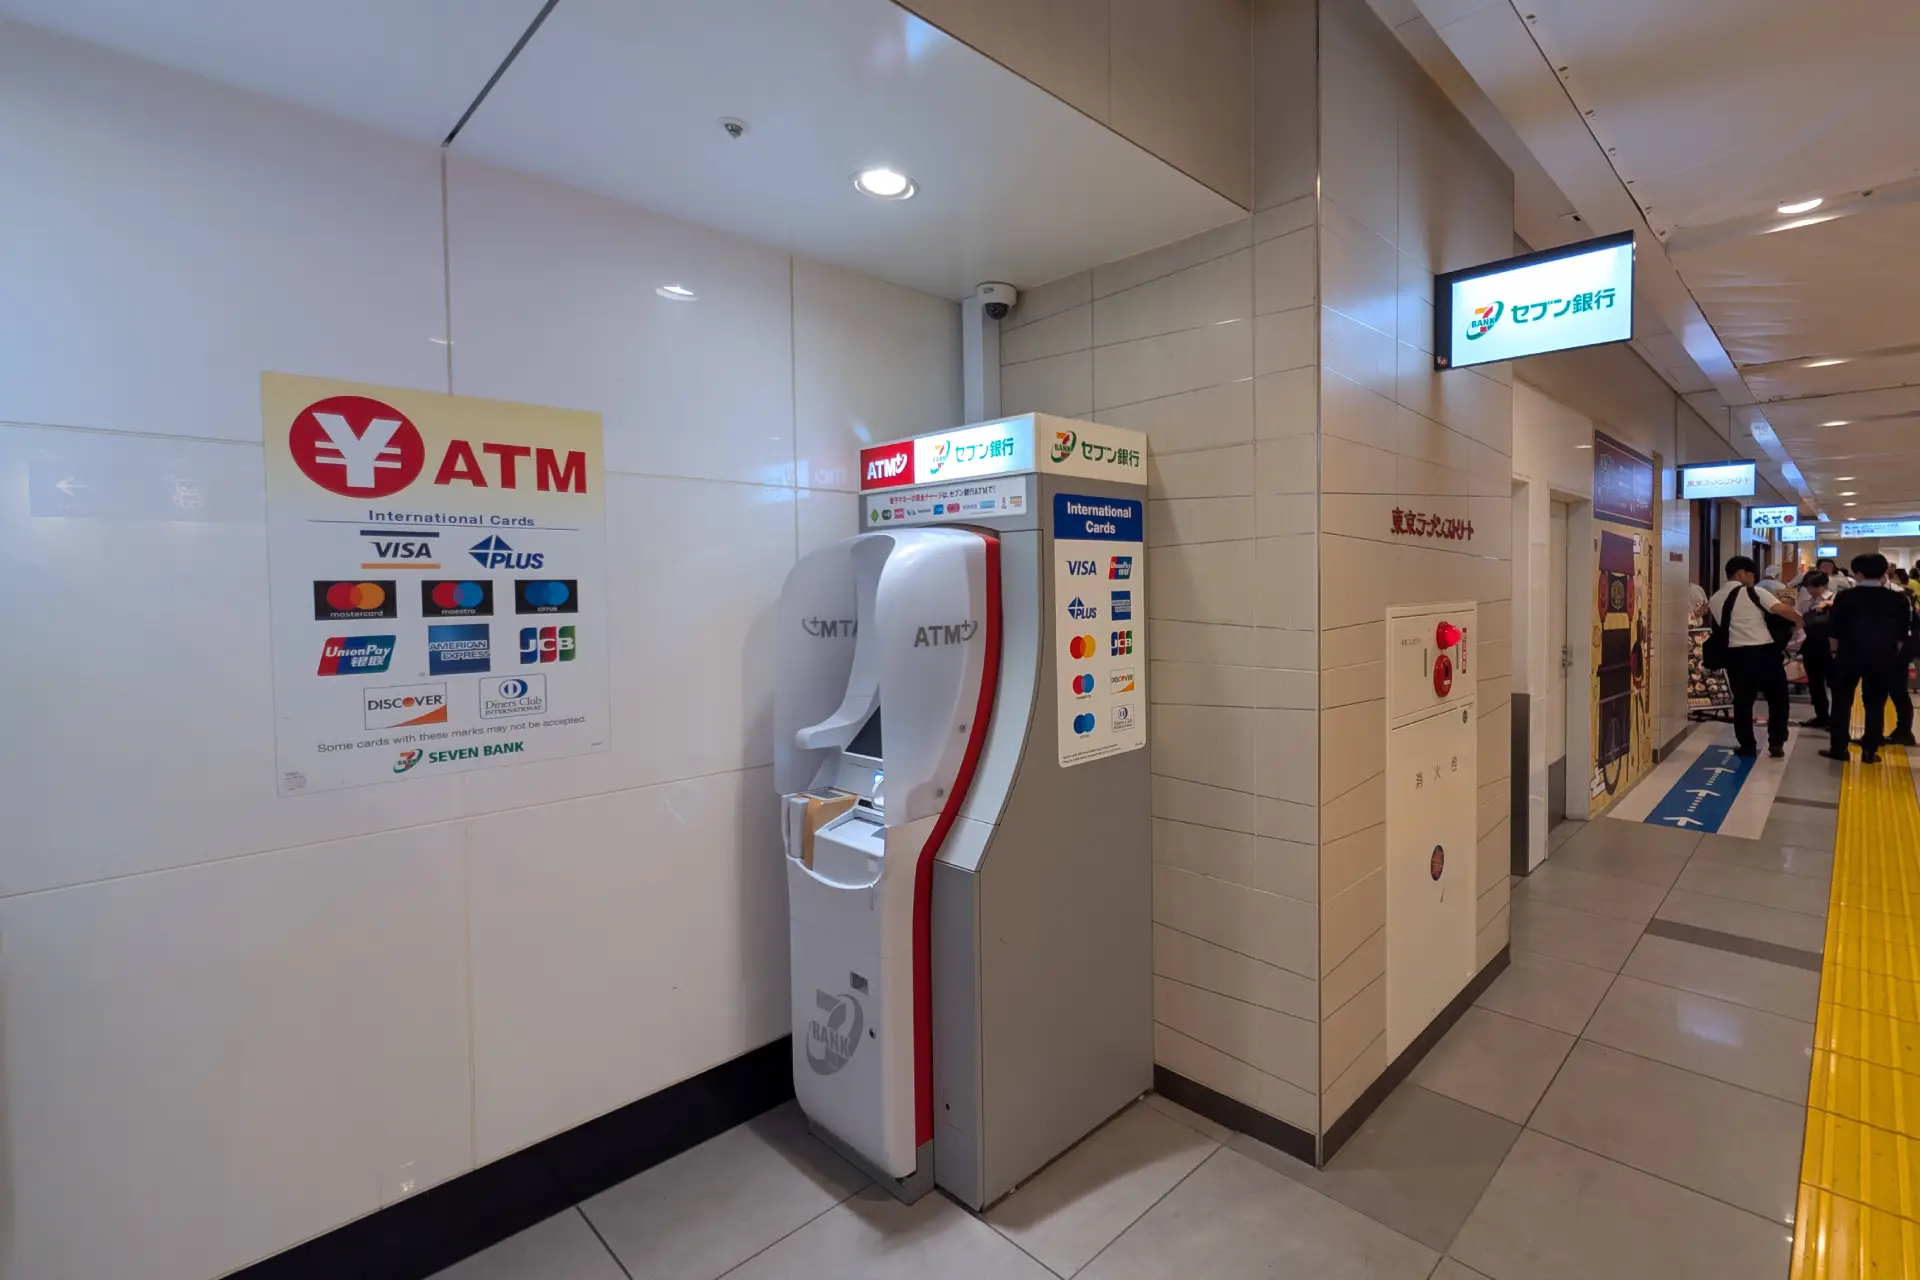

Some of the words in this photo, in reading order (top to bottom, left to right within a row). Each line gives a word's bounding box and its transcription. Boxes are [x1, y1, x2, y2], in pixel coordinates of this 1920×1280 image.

[1511, 288, 1616, 324] セブン銀行
[1472, 317, 1496, 329] BANK
[955, 437, 1014, 463] セブン銀行
[1081, 440, 1140, 467] セブン銀行
[434, 439, 587, 494] ATM
[369, 510, 483, 525] International
[490, 514, 535, 527] Cards
[1067, 501, 1132, 519] International
[1085, 520, 1116, 535] Cards
[369, 540, 432, 559] VISA
[490, 552, 545, 570] PLUS
[1066, 559, 1097, 576] VISA
[330, 609, 384, 619] mastercard
[441, 607, 476, 616] maestro
[1075, 606, 1097, 620] PLUS
[325, 644, 392, 659] UnionPay
[429, 640, 488, 652] AMERICAN
[442, 650, 491, 661] EXPRESS
[367, 694, 442, 711] DISCOVER
[485, 698, 516, 710] Diners
[519, 696, 542, 707] Club
[318, 741, 353, 753] Some
[356, 736, 390, 748] cards
[393, 732, 416, 744] with
[419, 730, 448, 742] these
[452, 726, 484, 738] marks
[487, 723, 507, 735] may
[509, 721, 525, 731] not
[528, 719, 541, 728] be
[543, 715, 586, 727] accepted.
[429, 747, 479, 764] SEVEN
[483, 741, 524, 757] BANK
[811, 1020, 852, 1057] BANK
